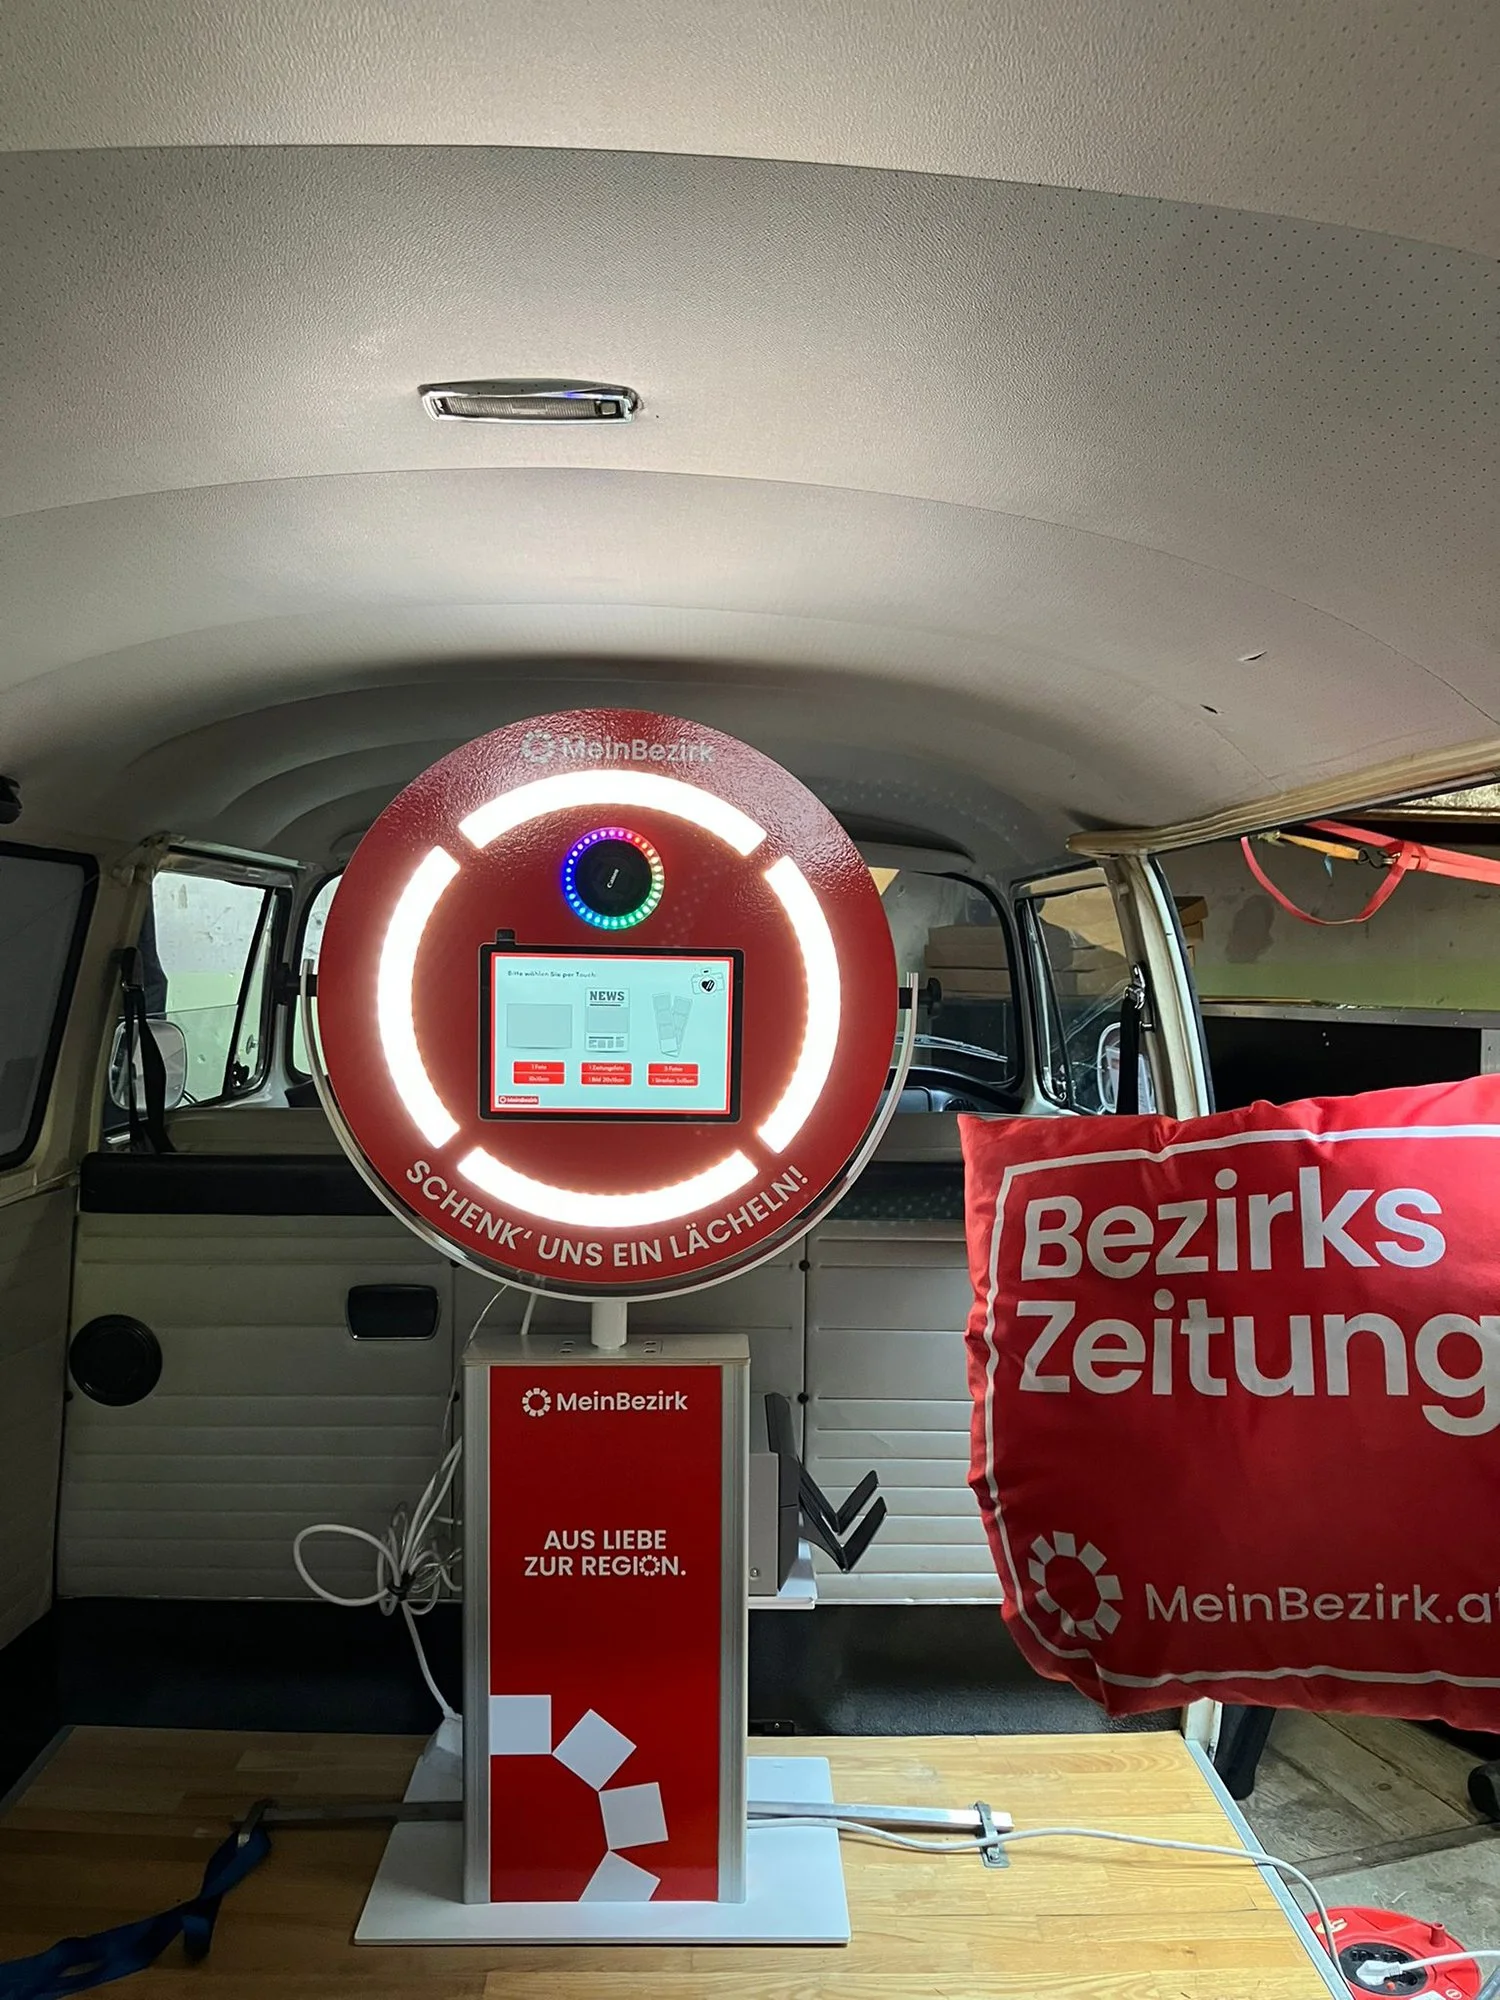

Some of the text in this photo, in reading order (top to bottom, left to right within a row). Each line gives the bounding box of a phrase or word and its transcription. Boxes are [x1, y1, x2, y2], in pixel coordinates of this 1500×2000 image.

[560, 736, 716, 761] MeinBezirk
[590, 991, 625, 1001] NEWS
[538, 1234, 603, 1266] UNS
[613, 1239, 662, 1267] EIN
[669, 1165, 809, 1259] LÄCHELN!
[1020, 1165, 1446, 1281] Bezirks
[1016, 1288, 1500, 1437] Zeitung
[556, 1390, 688, 1411] MeinBezirk
[544, 1530, 667, 1550] AUS LIEBE
[524, 1555, 687, 1577] ZUR REGION.
